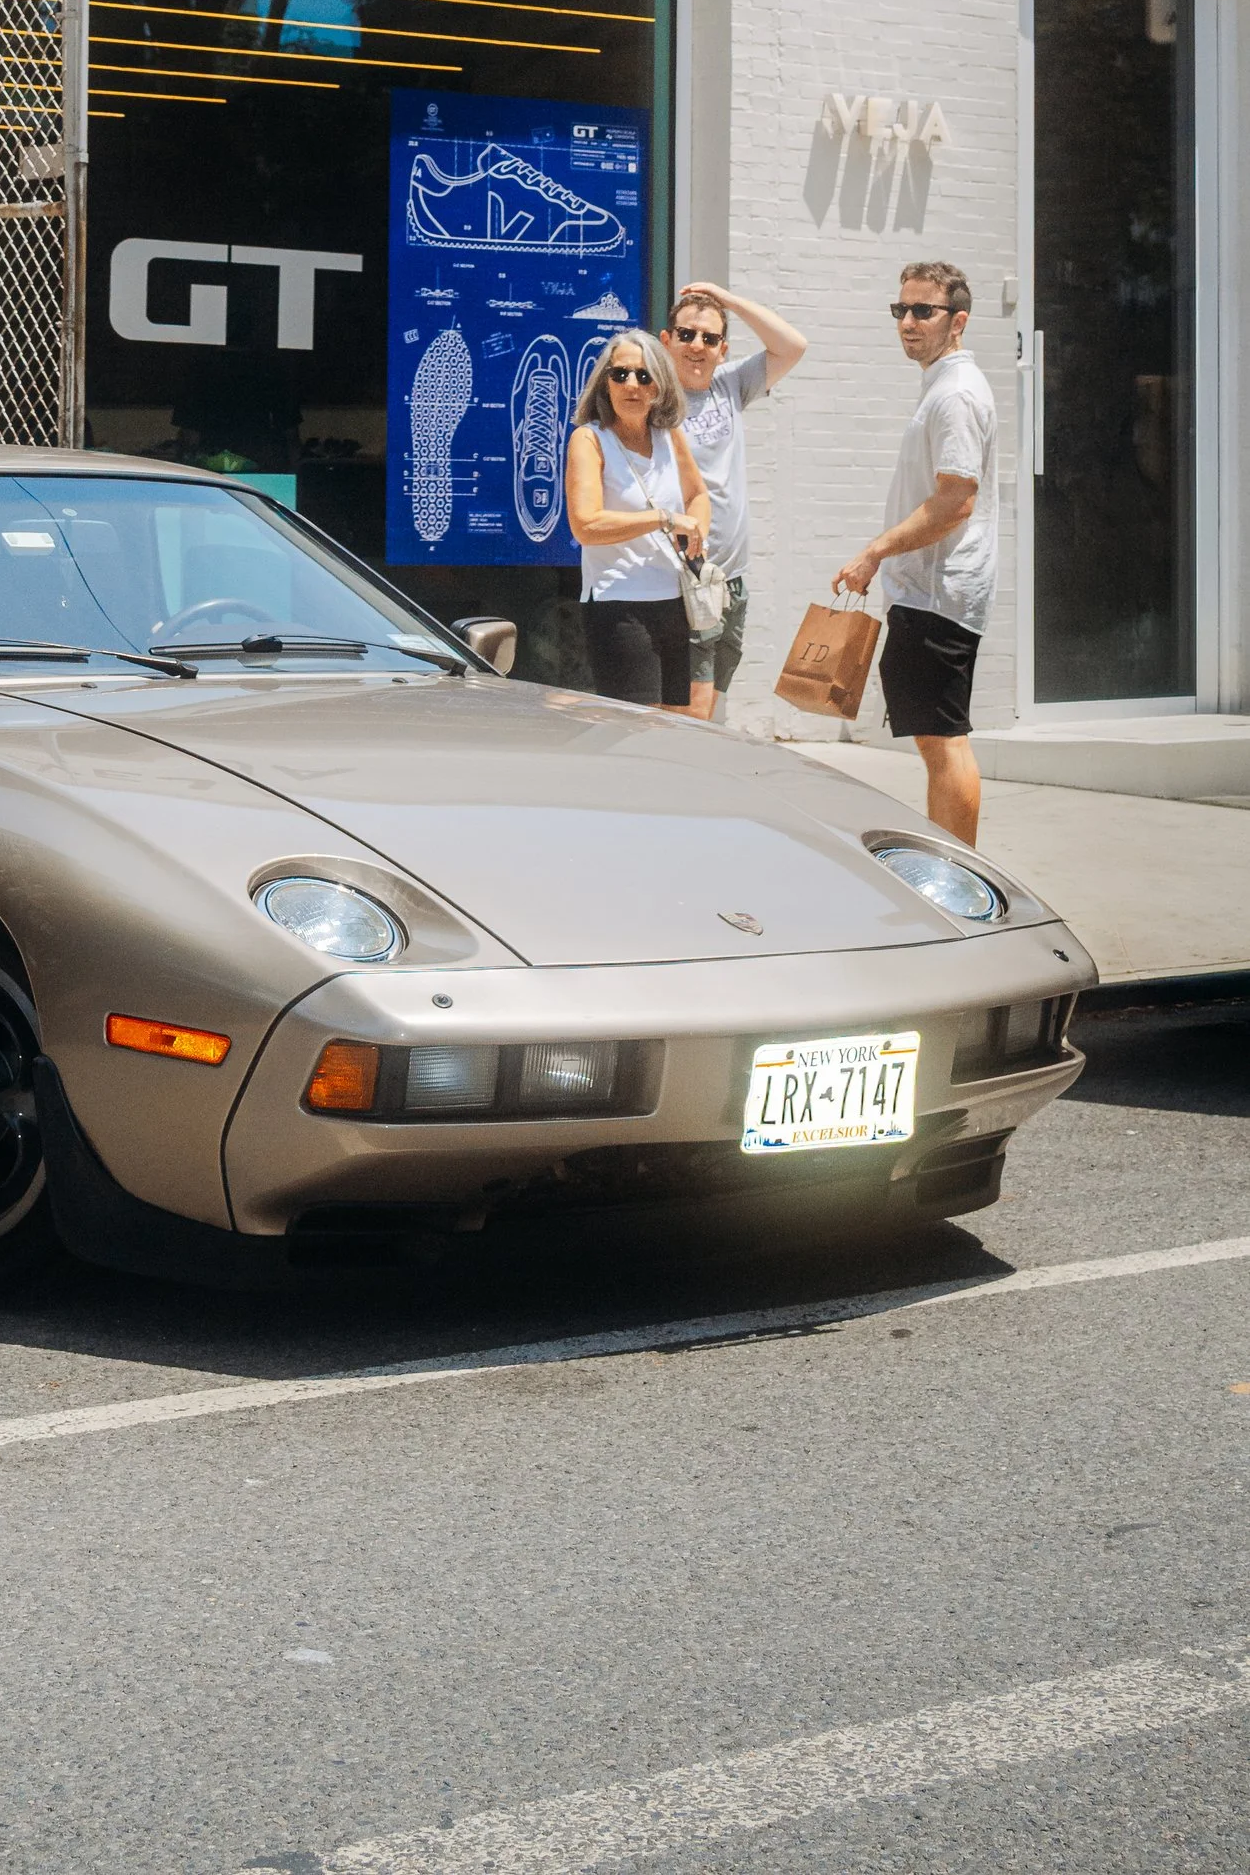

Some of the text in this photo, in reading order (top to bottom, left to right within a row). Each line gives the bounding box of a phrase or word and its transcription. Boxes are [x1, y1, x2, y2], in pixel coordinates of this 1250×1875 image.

[830, 92, 953, 146] VEJA
[573, 125, 599, 138] GT
[109, 237, 363, 350] GT
[800, 641, 830, 663] ID
[797, 1044, 881, 1068] NEW YORK
[760, 1062, 905, 1126] LRX 7147
[792, 1125, 869, 1143] EXCELSIOR
